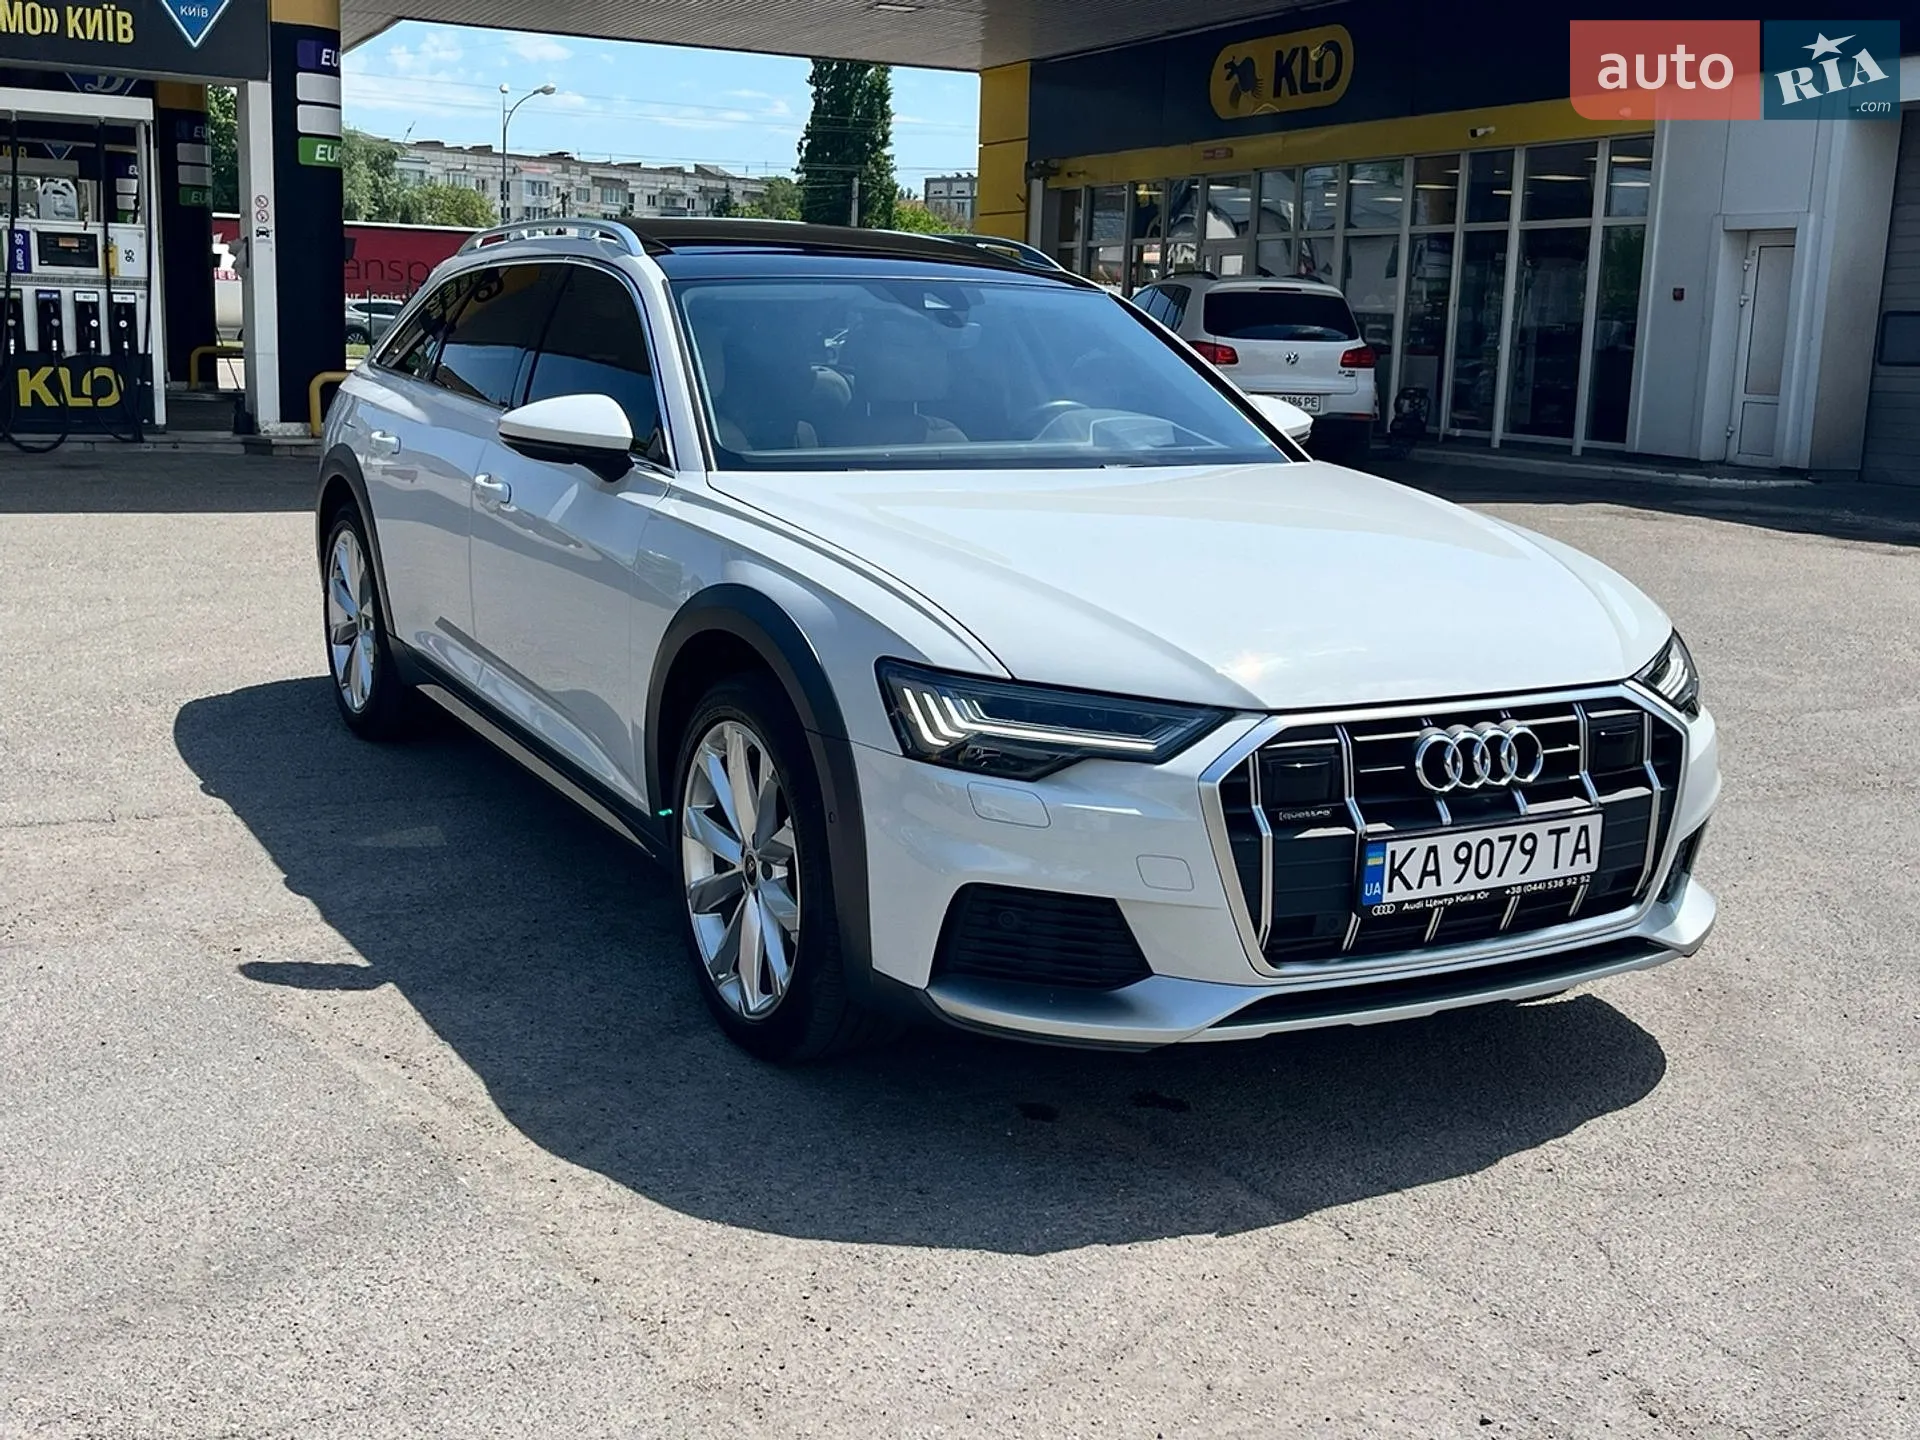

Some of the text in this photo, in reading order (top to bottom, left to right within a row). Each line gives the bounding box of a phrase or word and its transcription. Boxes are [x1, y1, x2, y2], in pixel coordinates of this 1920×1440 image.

[66, 4, 134, 43] КИЇВ
[1273, 40, 1343, 98] KLO
[17, 366, 124, 407] KLO
[1387, 824, 1592, 894] KA 9079 TA
[1365, 882, 1382, 897] UA
[1504, 885, 1523, 896] +38
[1547, 880, 1565, 890] 536
[1566, 876, 1578, 886] 92
[1402, 900, 1424, 912] Audi
